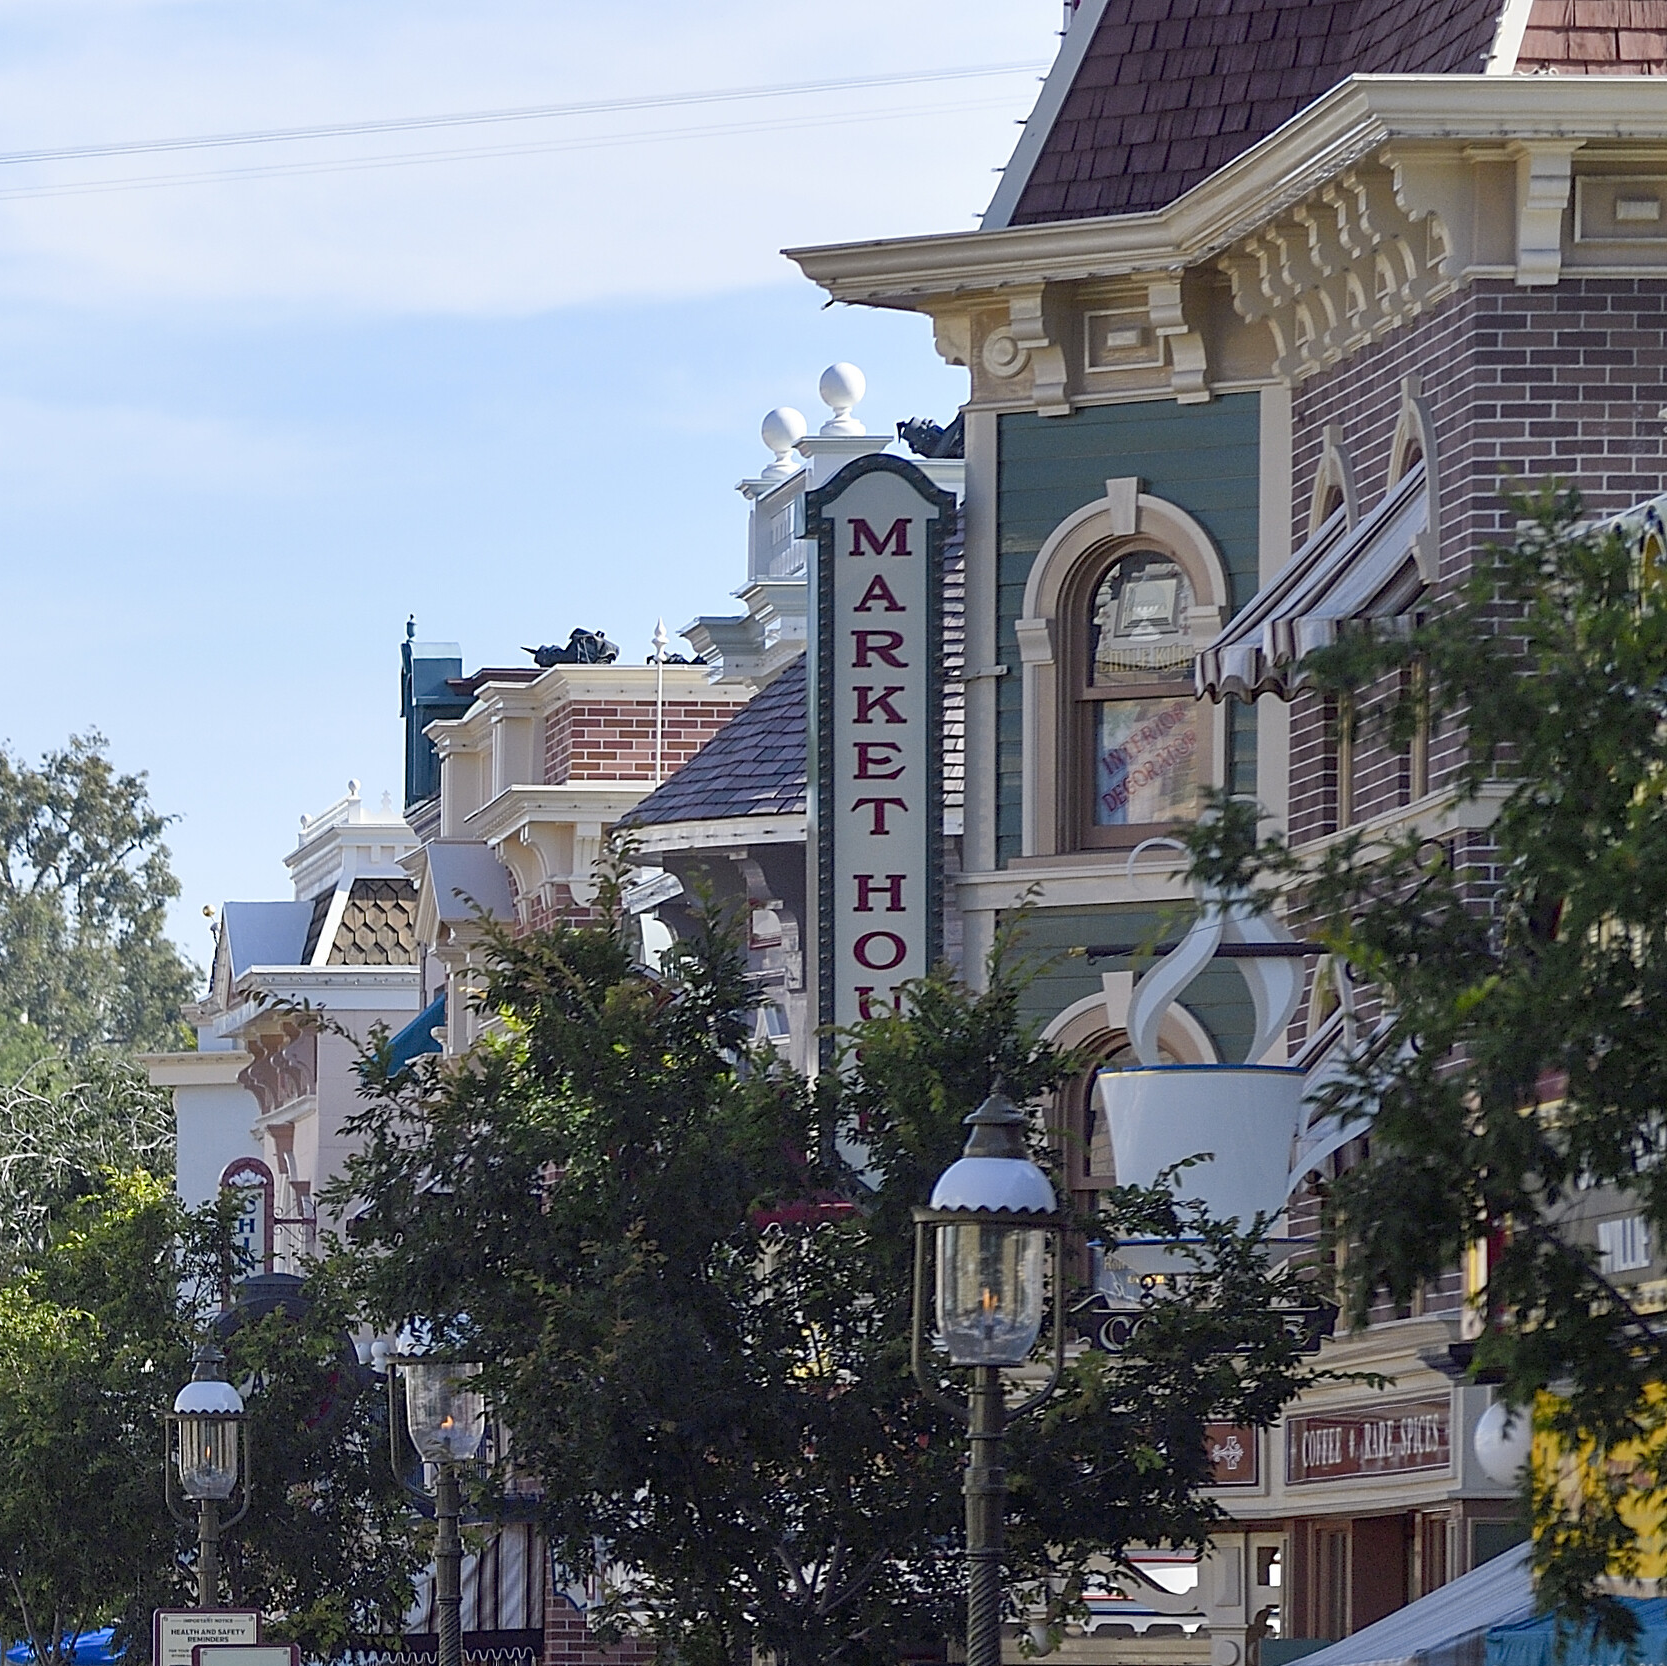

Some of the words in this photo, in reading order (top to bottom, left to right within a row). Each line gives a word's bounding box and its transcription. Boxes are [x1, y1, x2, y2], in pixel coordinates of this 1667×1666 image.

[847, 517, 913, 836] MARKET
[1101, 702, 1186, 776] INTERIOR
[1101, 730, 1197, 812] DECORATOR
[1302, 1427, 1343, 1467] COFFEE
[1364, 1420, 1394, 1460] RARE
[1400, 1413, 1440, 1456] SPICES
[170, 1628, 200, 1636] HEALTH
[200, 1628, 217, 1636] AND
[217, 1628, 246, 1636] SAFETY
